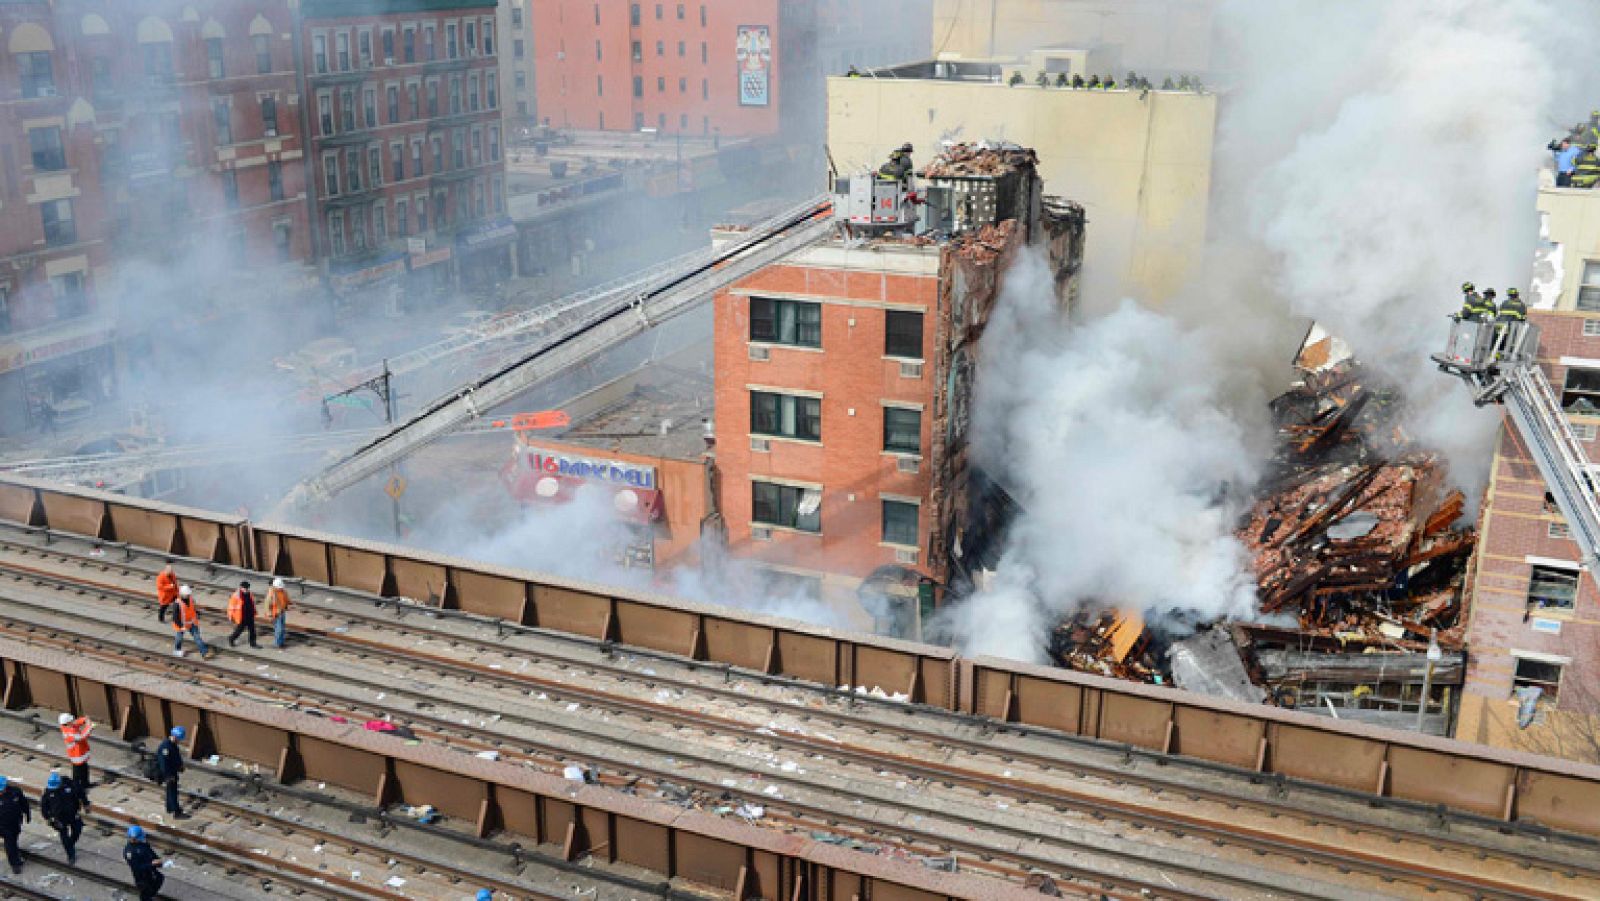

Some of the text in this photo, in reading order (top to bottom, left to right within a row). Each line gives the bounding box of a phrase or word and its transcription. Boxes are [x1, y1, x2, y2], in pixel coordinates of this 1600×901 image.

[528, 453, 652, 487] 116 PARK DELI
